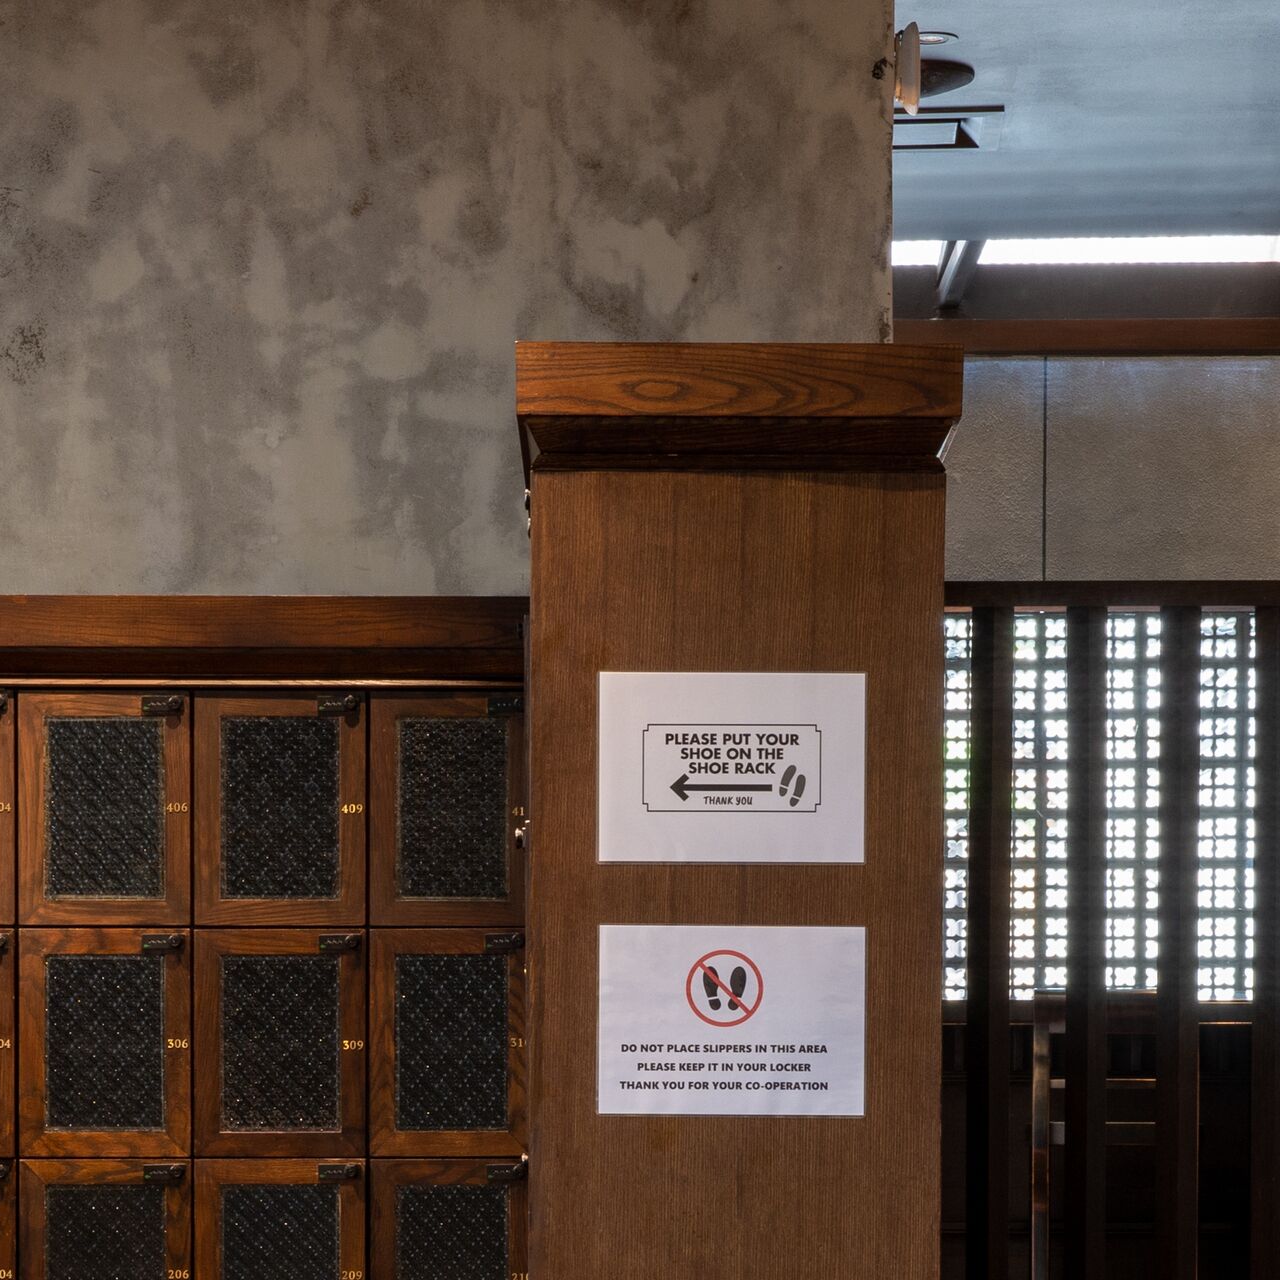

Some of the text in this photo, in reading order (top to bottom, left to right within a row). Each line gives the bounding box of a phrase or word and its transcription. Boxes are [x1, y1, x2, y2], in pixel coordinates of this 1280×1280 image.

[665, 732, 800, 746] PLEASE PUT YOUR
[680, 747, 784, 761] SHOE ON THE
[688, 761, 776, 775] SHOE RACK
[703, 795, 753, 806] THANK YOU
[166, 802, 188, 813] 406
[341, 803, 363, 814] 409
[167, 1038, 189, 1049] 306
[342, 1039, 364, 1051] 309
[621, 1043, 828, 1054] DO NOT PLACE SLIPPERS IN THIS AREA
[637, 1062, 812, 1073] PLEASE KEEP IT IN YOUR LOCKER
[619, 1080, 829, 1091] THANK YOU FOR YOUR CO-OPERATION
[168, 1269, 190, 1280] 206
[341, 1270, 363, 1280] 209
